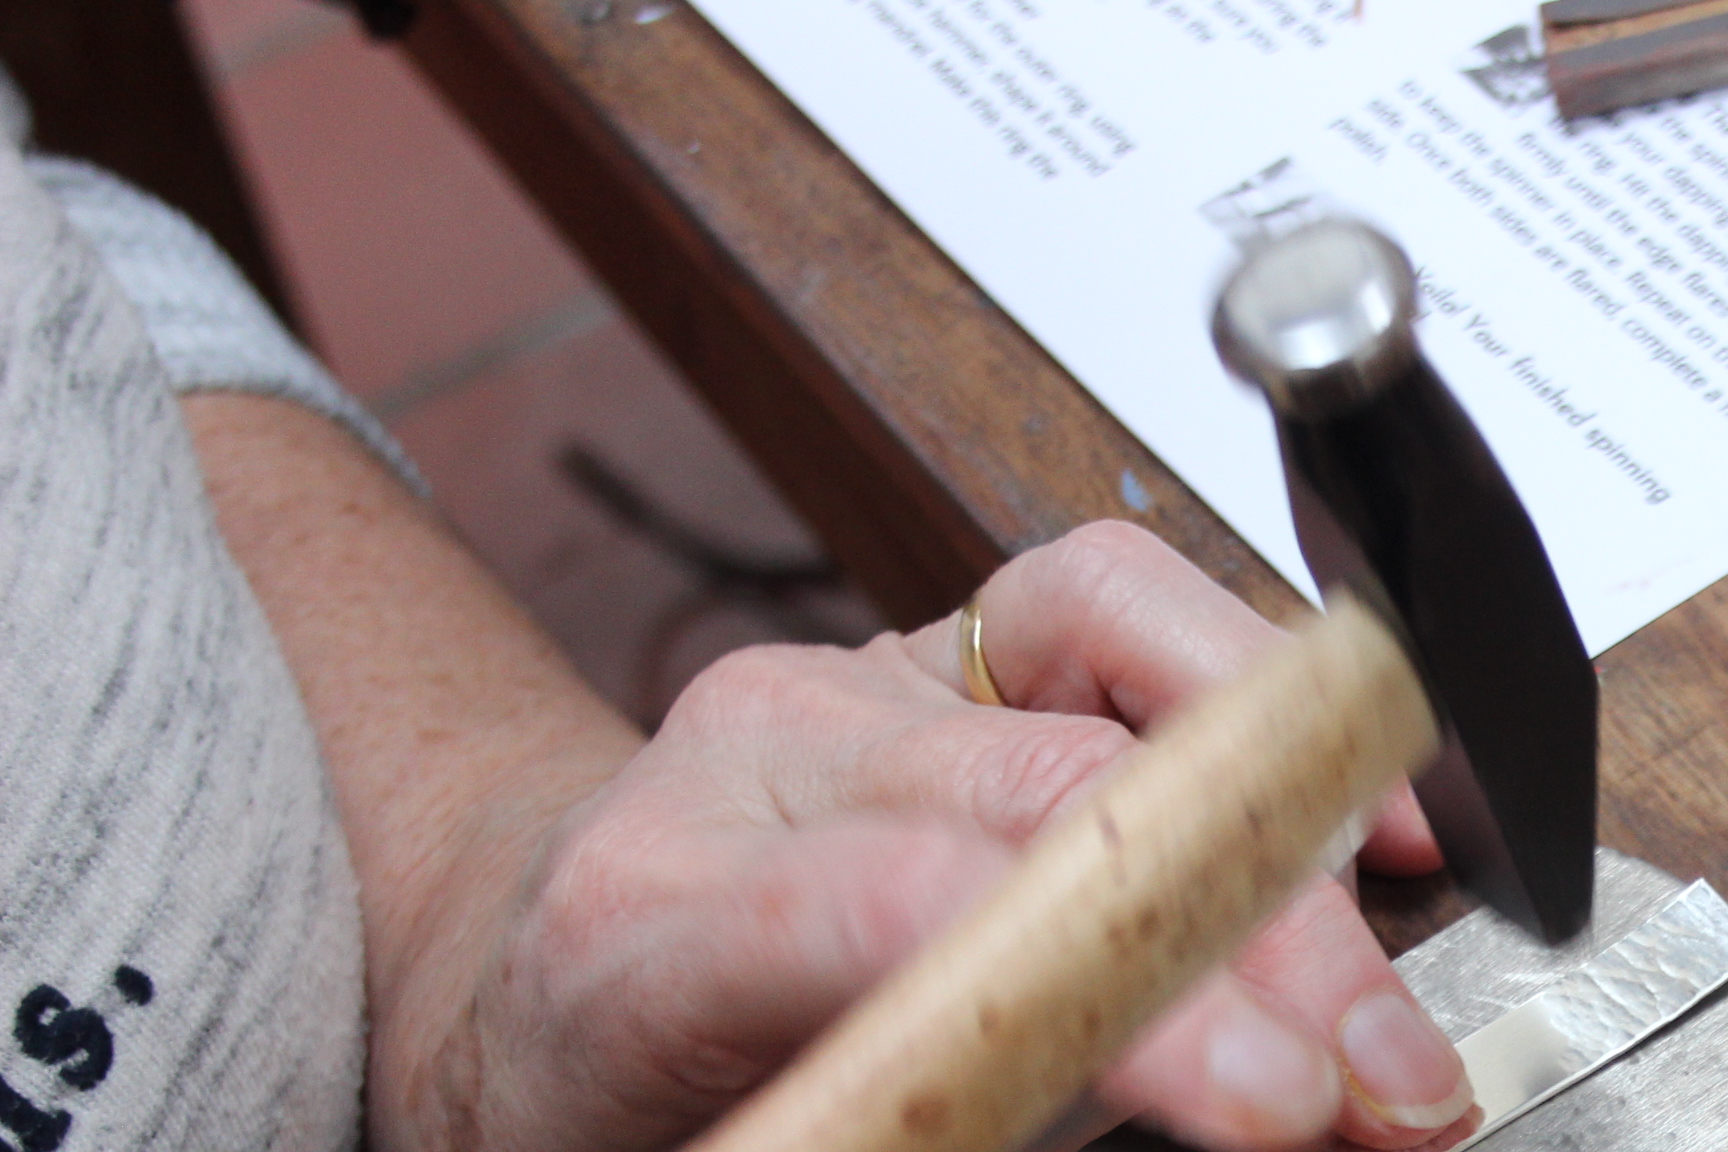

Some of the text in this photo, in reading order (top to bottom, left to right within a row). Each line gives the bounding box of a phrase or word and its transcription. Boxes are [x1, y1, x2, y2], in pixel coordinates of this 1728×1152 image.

[1417, 95, 1463, 133] keep
[1459, 130, 1492, 157] the
[1487, 155, 1555, 211] spinner
[1551, 210, 1577, 238] in
[1623, 269, 1692, 327] Repeat
[1684, 324, 1718, 350] on
[1514, 129, 1568, 178] firmly
[1563, 175, 1614, 212] until
[1604, 207, 1639, 236] the
[1635, 235, 1683, 273] edge
[1614, 123, 1666, 165] your
[1645, 195, 1680, 223] the
[1404, 130, 1454, 170] Once
[1447, 166, 1495, 206] both
[1489, 204, 1538, 246] sides
[1532, 244, 1569, 270] are
[1620, 317, 1709, 389] complete
[1463, 312, 1509, 357] Your
[1508, 354, 1597, 428] finished
[1583, 426, 1672, 506] spinning
